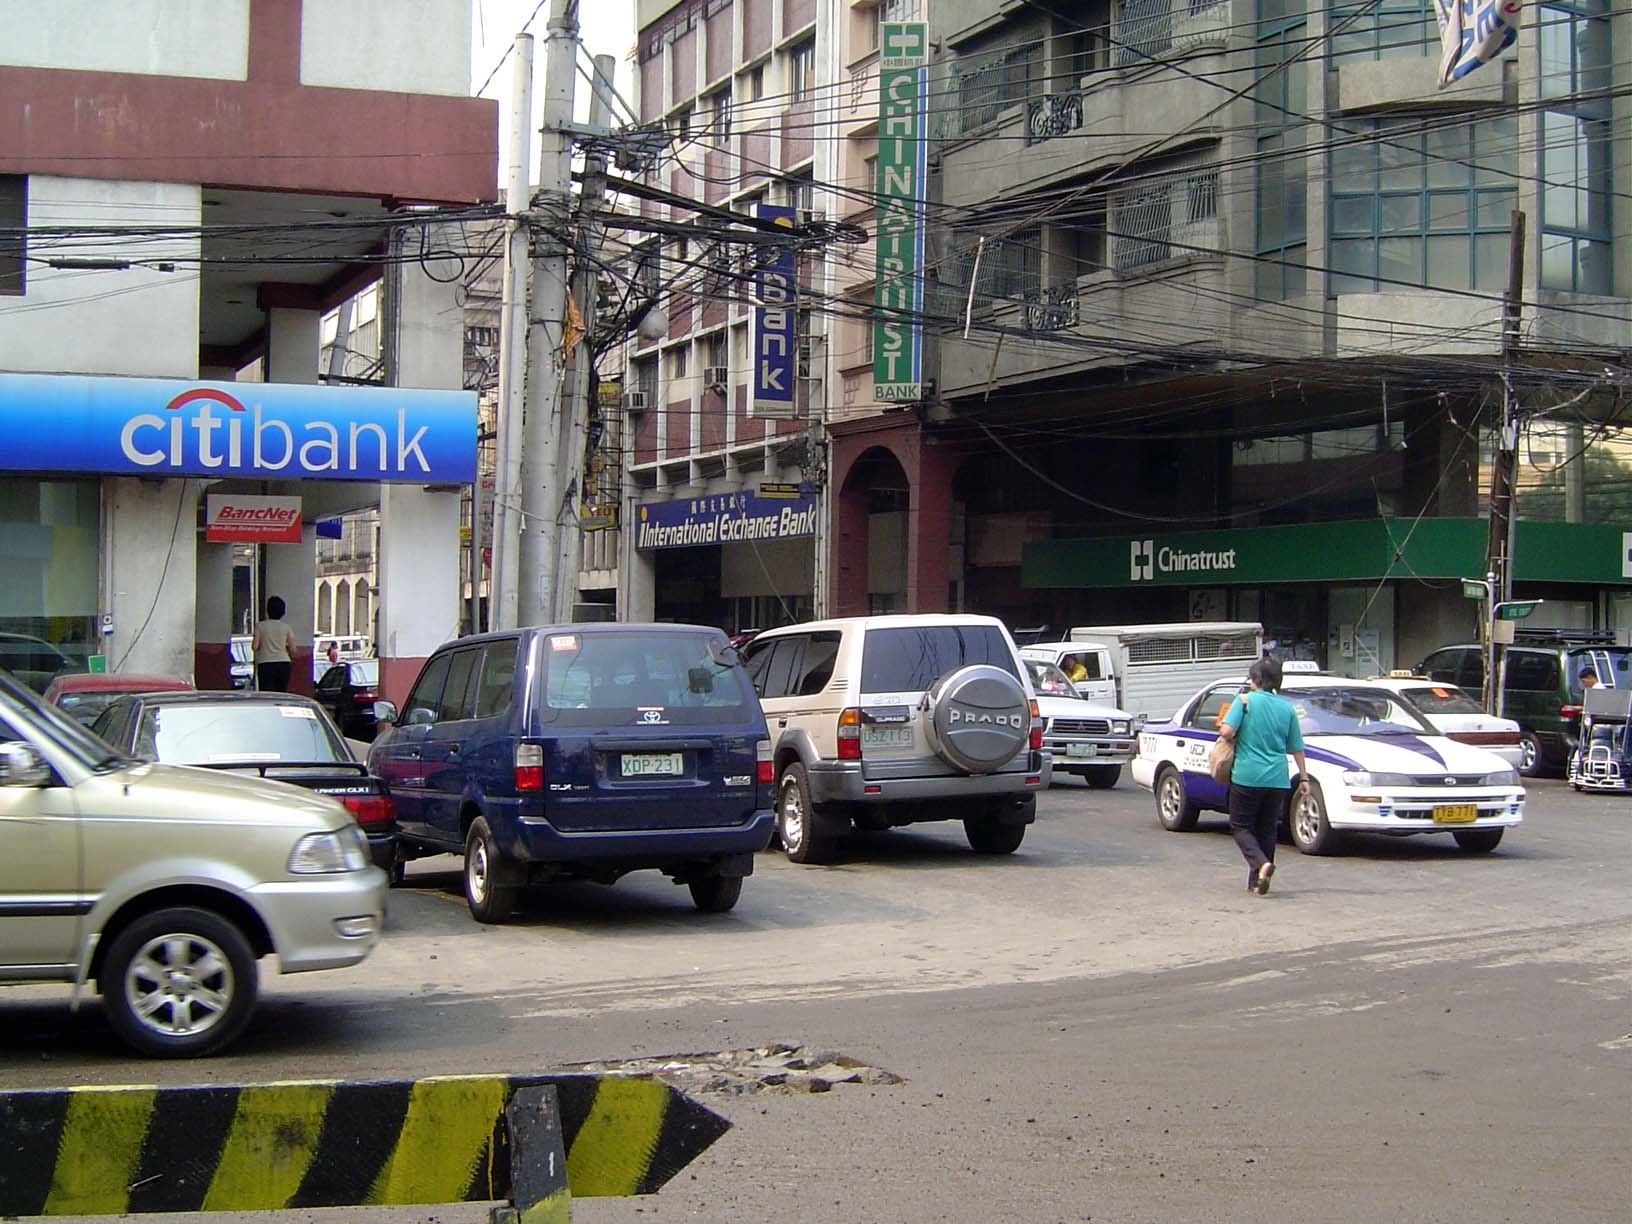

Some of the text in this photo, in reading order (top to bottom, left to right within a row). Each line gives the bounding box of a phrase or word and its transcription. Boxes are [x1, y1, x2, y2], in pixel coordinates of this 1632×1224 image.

[882, 75, 912, 380] CHINATRUST
[762, 216, 794, 391] Bank
[875, 385, 917, 399] BANK
[120, 402, 431, 472] citibank
[219, 506, 297, 519] BancNet
[644, 514, 720, 547] International
[720, 512, 779, 541] Exchange
[779, 503, 816, 536] Bank
[1158, 547, 1236, 571] Chinatrust
[949, 707, 1022, 729] PRADO
